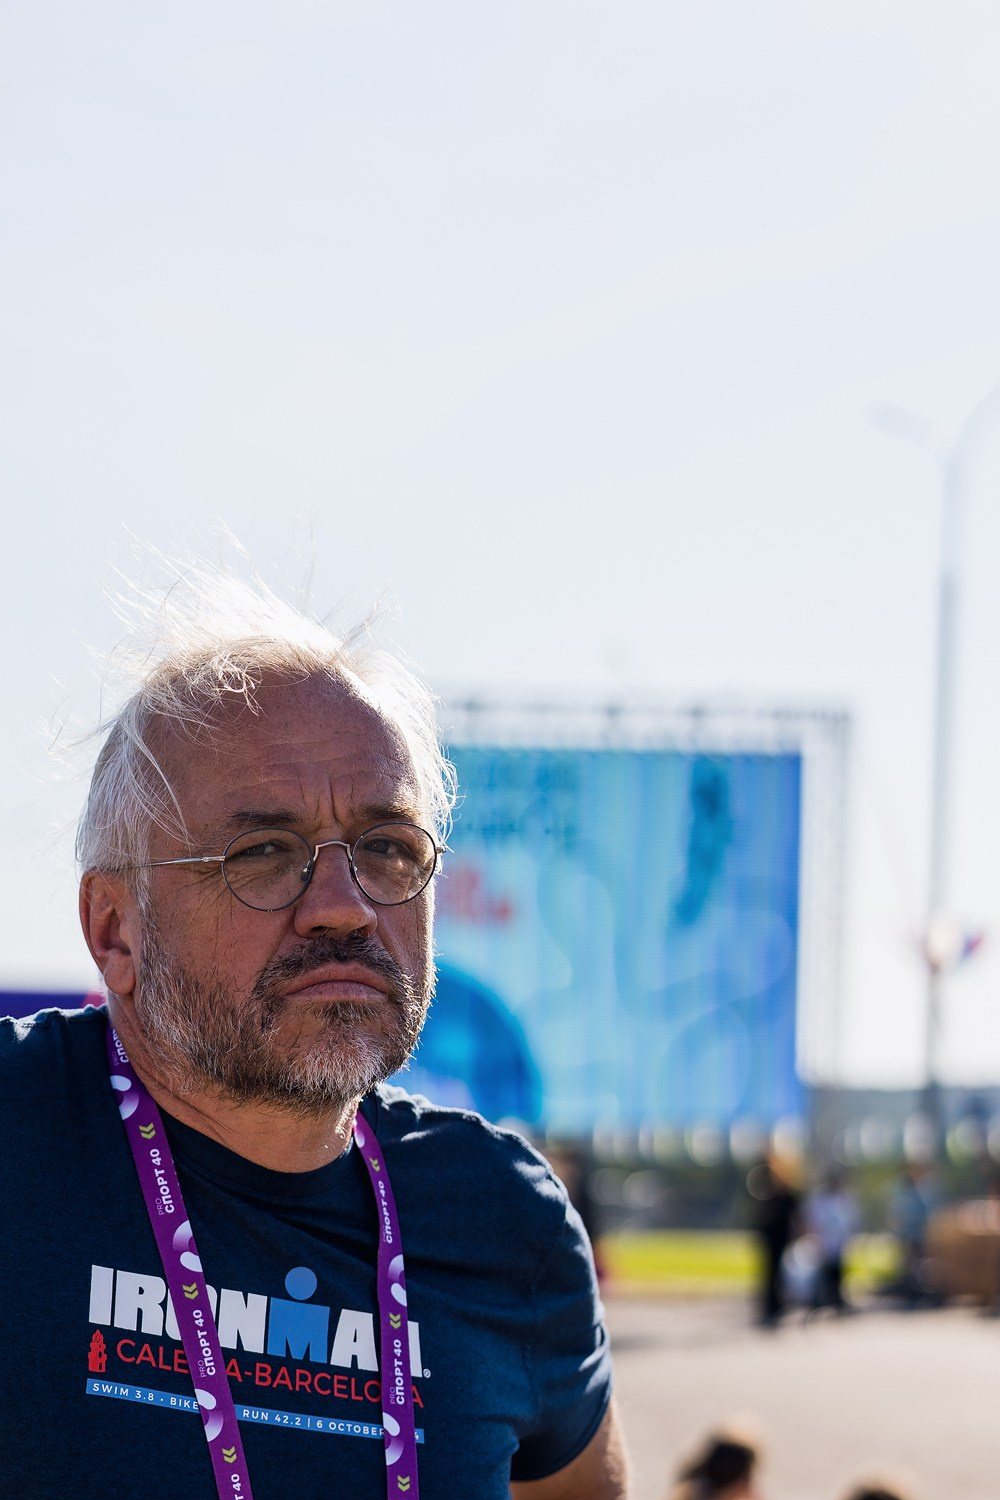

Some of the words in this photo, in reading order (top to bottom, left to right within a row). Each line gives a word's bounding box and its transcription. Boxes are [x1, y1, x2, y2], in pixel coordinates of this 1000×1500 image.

[149, 1148, 162, 1166] 40
[154, 1168, 175, 1214] СПОРТ
[378, 1180, 386, 1198] 40
[155, 1198, 165, 1215] PRO
[381, 1198, 393, 1244] СПОРТ
[192, 1309, 205, 1327] 40
[197, 1330, 216, 1376] СПОРТ
[393, 1339, 402, 1357] 40
[198, 1360, 207, 1378] PRO
[394, 1358, 405, 1405] СПОРТ
[92, 1383, 129, 1397] SWIM
[135, 1390, 154, 1401] 3.8
[170, 1397, 199, 1410] BIKE
[242, 1409, 269, 1421] RUN
[275, 1414, 301, 1426] 42.2
[316, 1420, 323, 1429] 6
[231, 1473, 242, 1491] 40
